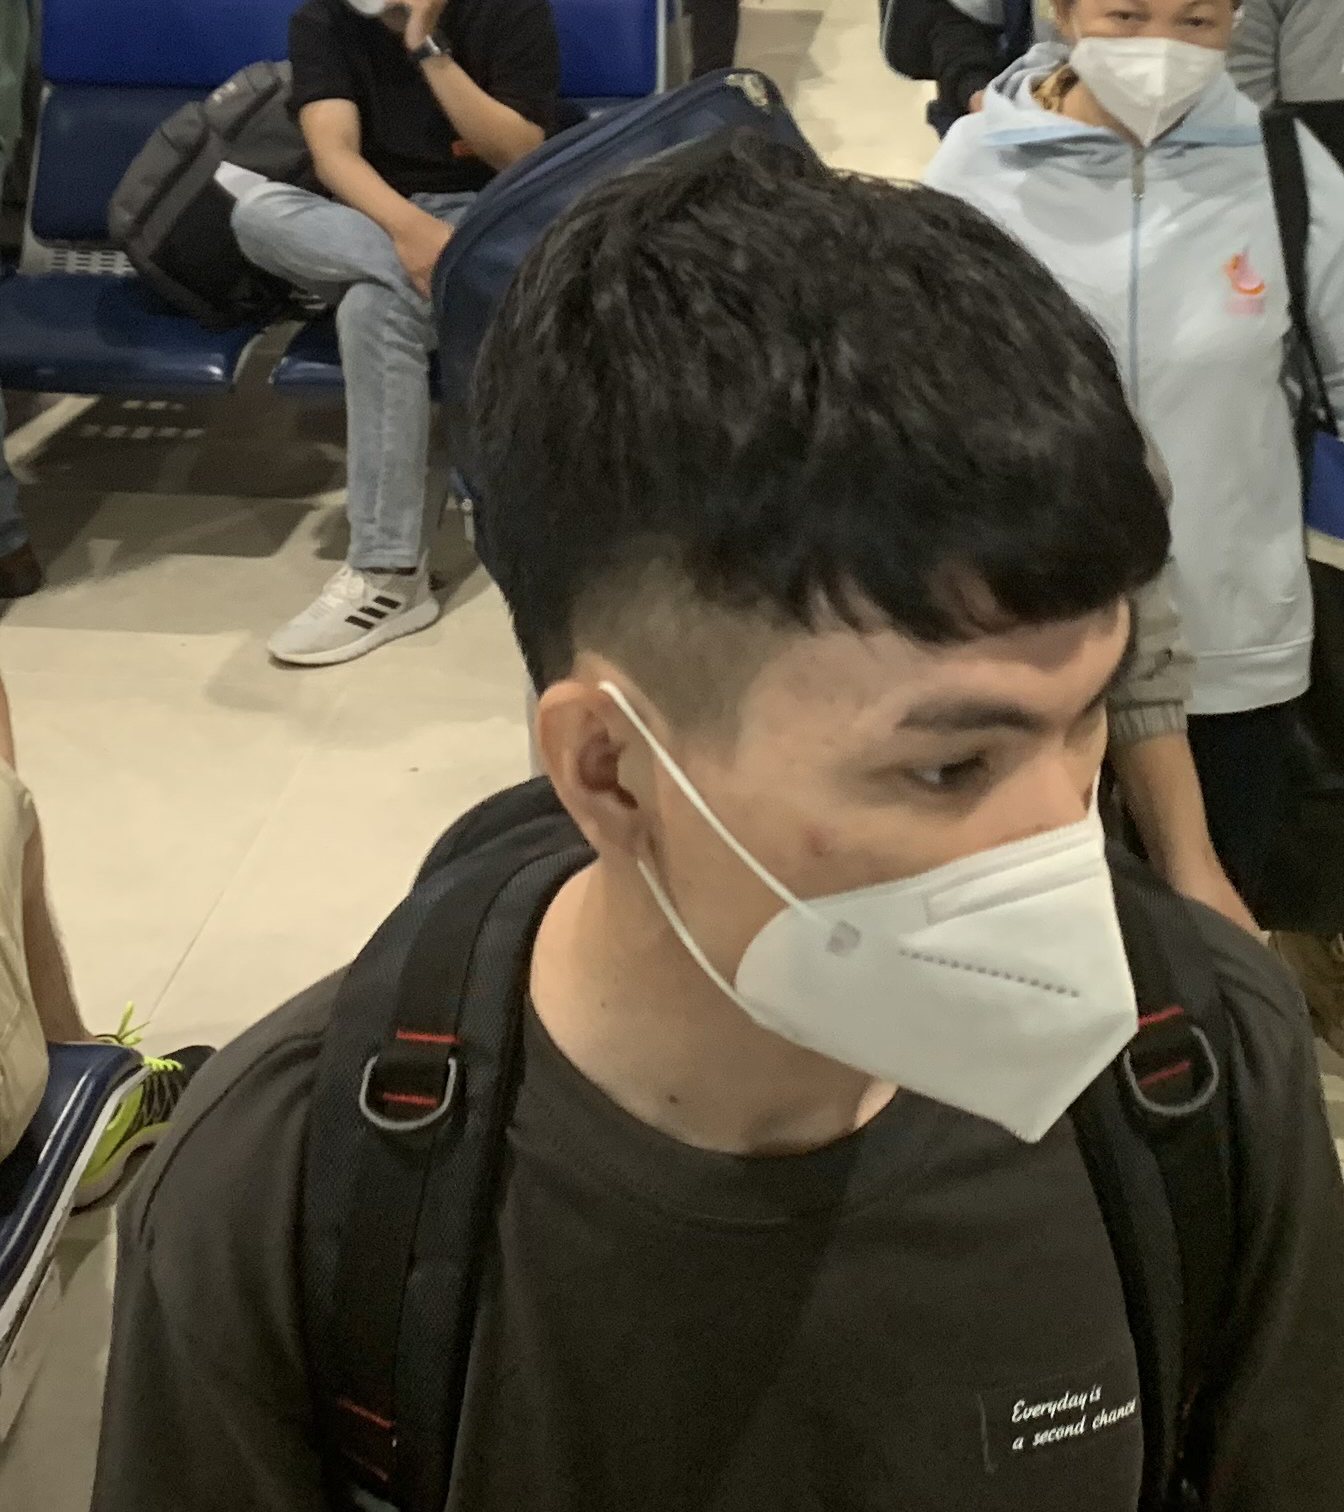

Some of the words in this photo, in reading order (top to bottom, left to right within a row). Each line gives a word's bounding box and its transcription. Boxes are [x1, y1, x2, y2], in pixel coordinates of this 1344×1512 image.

[1011, 1389, 1088, 1423] Everyday
[1089, 1383, 1103, 1404] is
[1012, 1435, 1025, 1451] a
[1032, 1413, 1086, 1447] second
